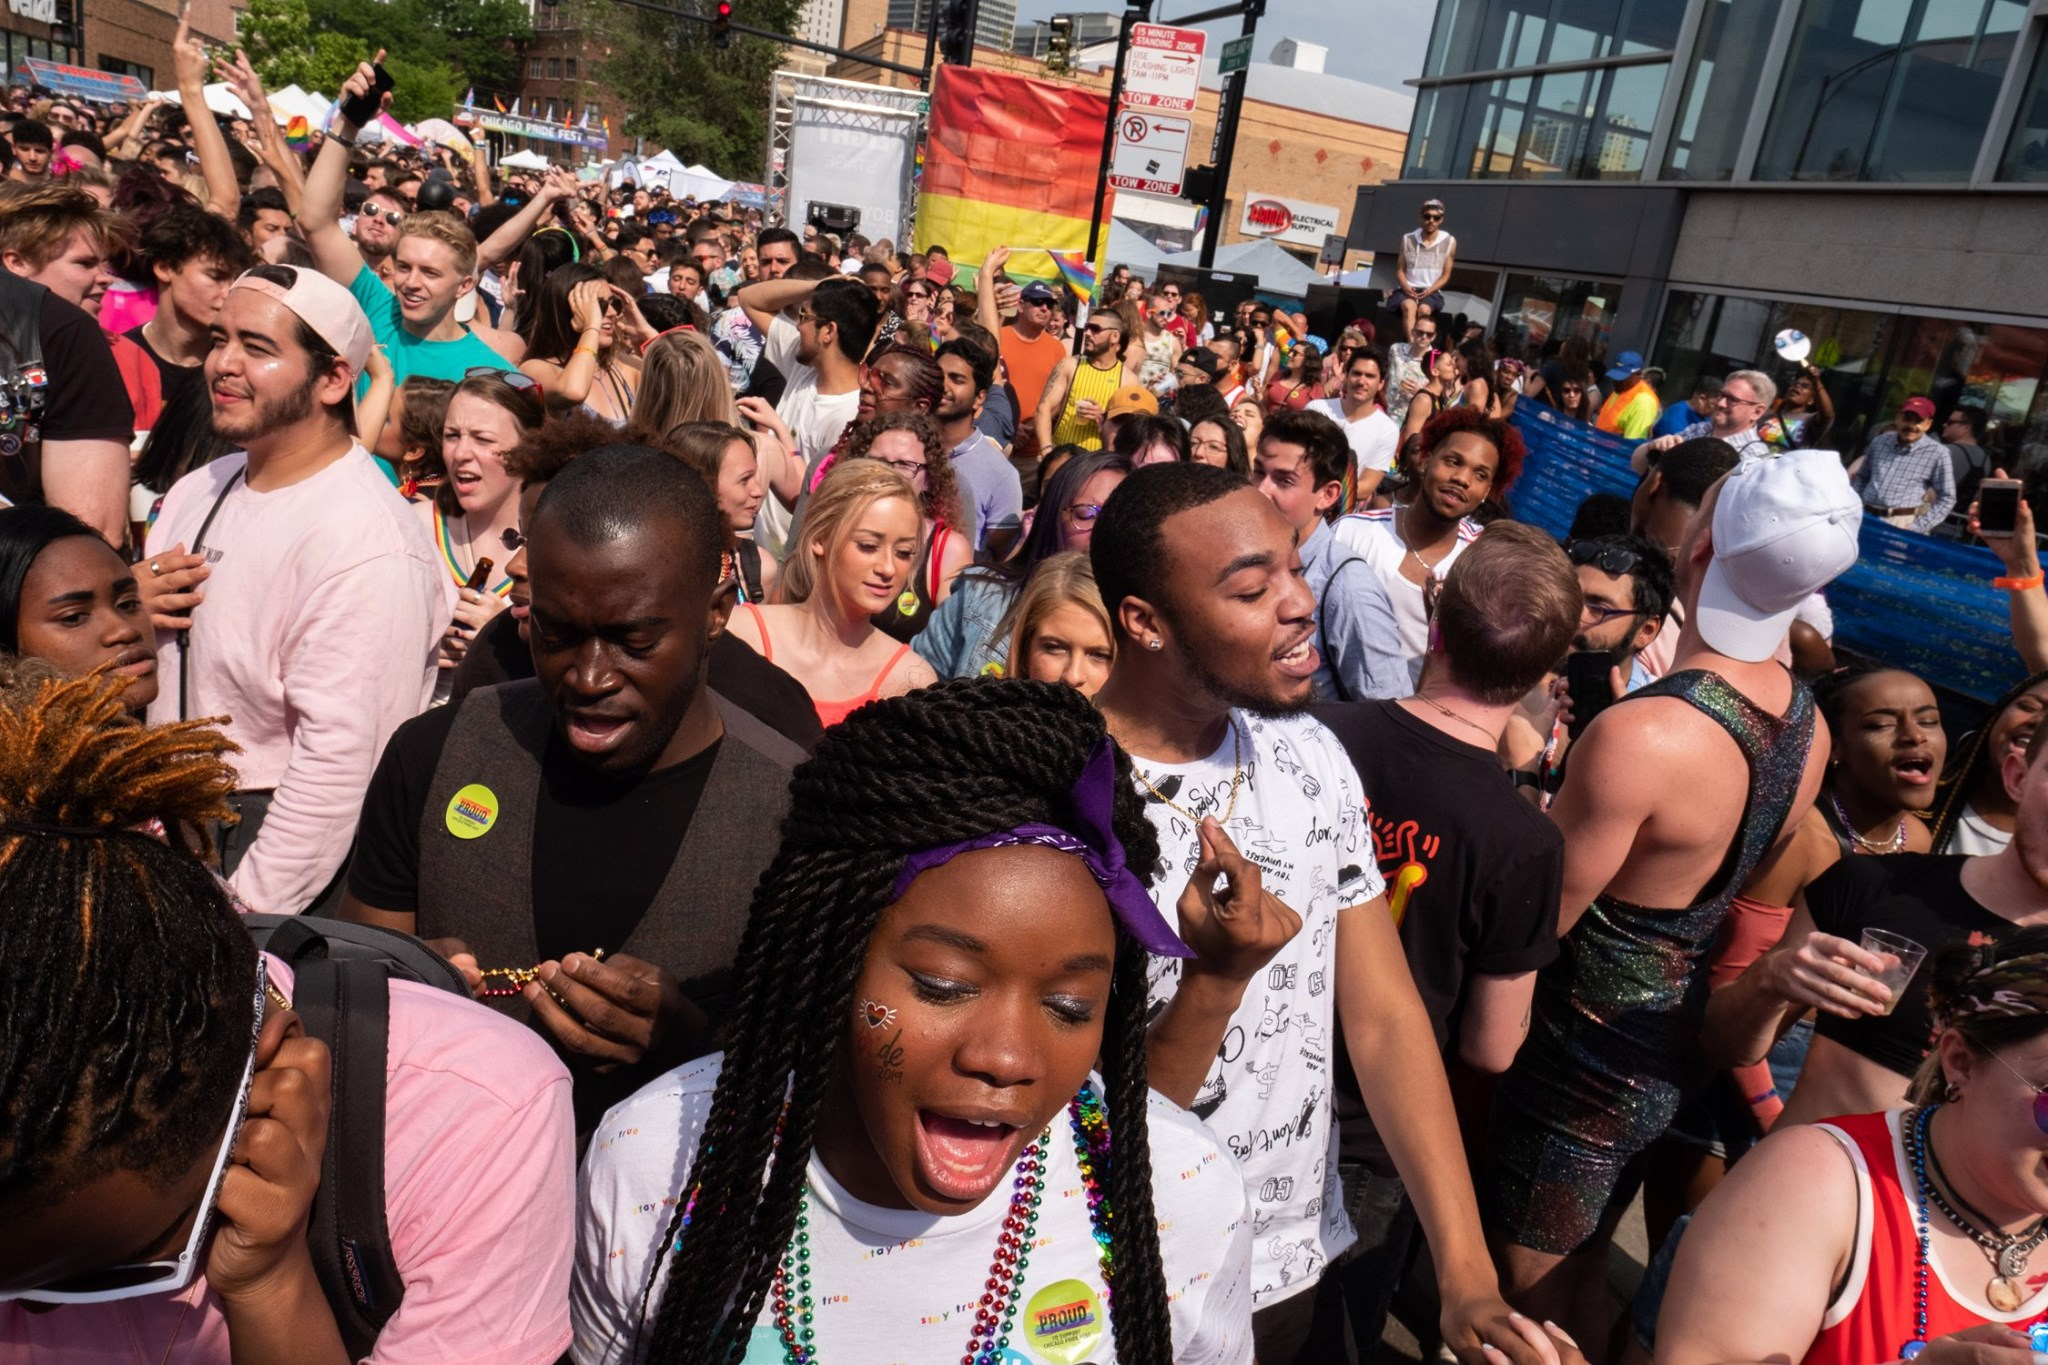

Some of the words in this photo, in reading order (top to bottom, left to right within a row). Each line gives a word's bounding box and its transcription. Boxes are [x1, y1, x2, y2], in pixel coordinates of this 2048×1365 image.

[1137, 26, 1146, 36] 15
[1147, 28, 1176, 40] MINUTE
[1135, 36, 1174, 49] STANDING
[1175, 41, 1197, 52] ZONE
[1133, 51, 1149, 60] USE
[1127, 92, 1152, 105] TOW
[1156, 95, 1188, 110] ZONE
[479, 114, 523, 132] CHICAGO
[526, 122, 554, 138] PRIDE
[558, 130, 583, 142] FEST
[1114, 176, 1138, 189] TOW
[1143, 179, 1174, 194] ZONE
[1291, 222, 1316, 233] SUPPLY
[1292, 214, 1334, 228] ELECTRICAL
[459, 800, 488, 821] PROUD
[877, 1066, 904, 1085] 2019
[863, 1245, 893, 1261] stay
[900, 1239, 925, 1250] you
[1031, 1237, 1053, 1250] you
[822, 1295, 849, 1306] true
[921, 1312, 949, 1324] stay
[956, 1302, 984, 1313] true
[1039, 1305, 1087, 1332] PROUD
